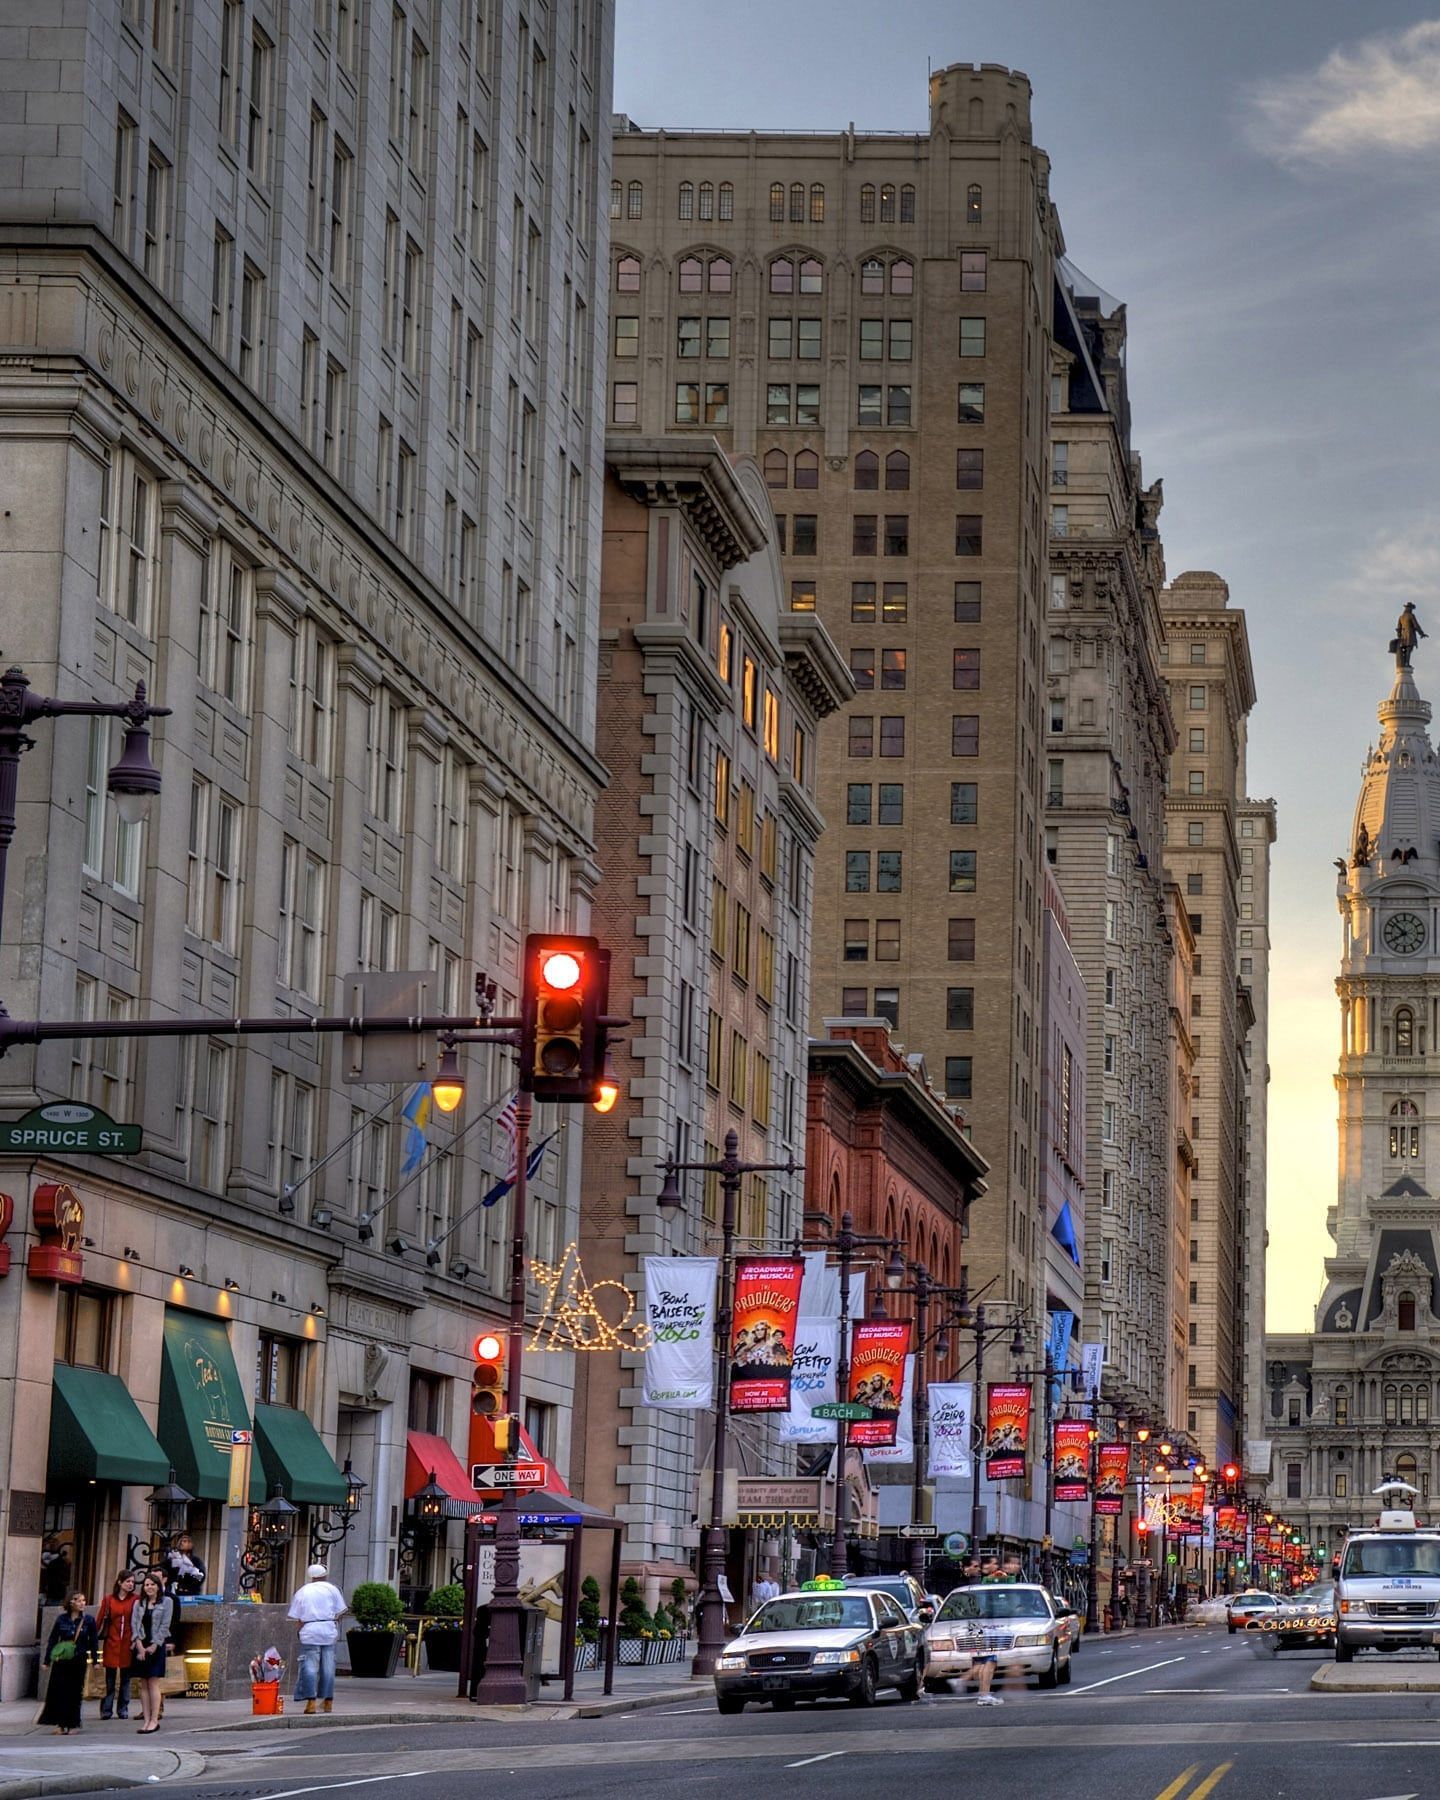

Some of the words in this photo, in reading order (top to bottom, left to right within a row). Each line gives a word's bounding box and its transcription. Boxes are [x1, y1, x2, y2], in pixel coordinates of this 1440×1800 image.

[63, 1109, 72, 1118] W
[9, 1129, 89, 1146] SPRUCE
[98, 1131, 125, 1147] ST.
[744, 1265, 794, 1274] BROADWAY'S
[741, 1273, 759, 1281] BEST
[759, 1272, 795, 1281] MUSICAL!
[733, 1291, 796, 1314] PRODUCERS
[650, 1303, 700, 1320] BAISERS
[654, 1327, 701, 1343] XOXO
[792, 1355, 832, 1370] FFETTO
[194, 1357, 219, 1388] Ted's
[822, 1408, 854, 1419] BACH
[494, 1471, 515, 1481] ONE
[518, 1471, 538, 1481] WAY
[764, 1495, 809, 1504] THEATER
[527, 1515, 539, 1523] 32
[921, 1527, 934, 1535] WAY
